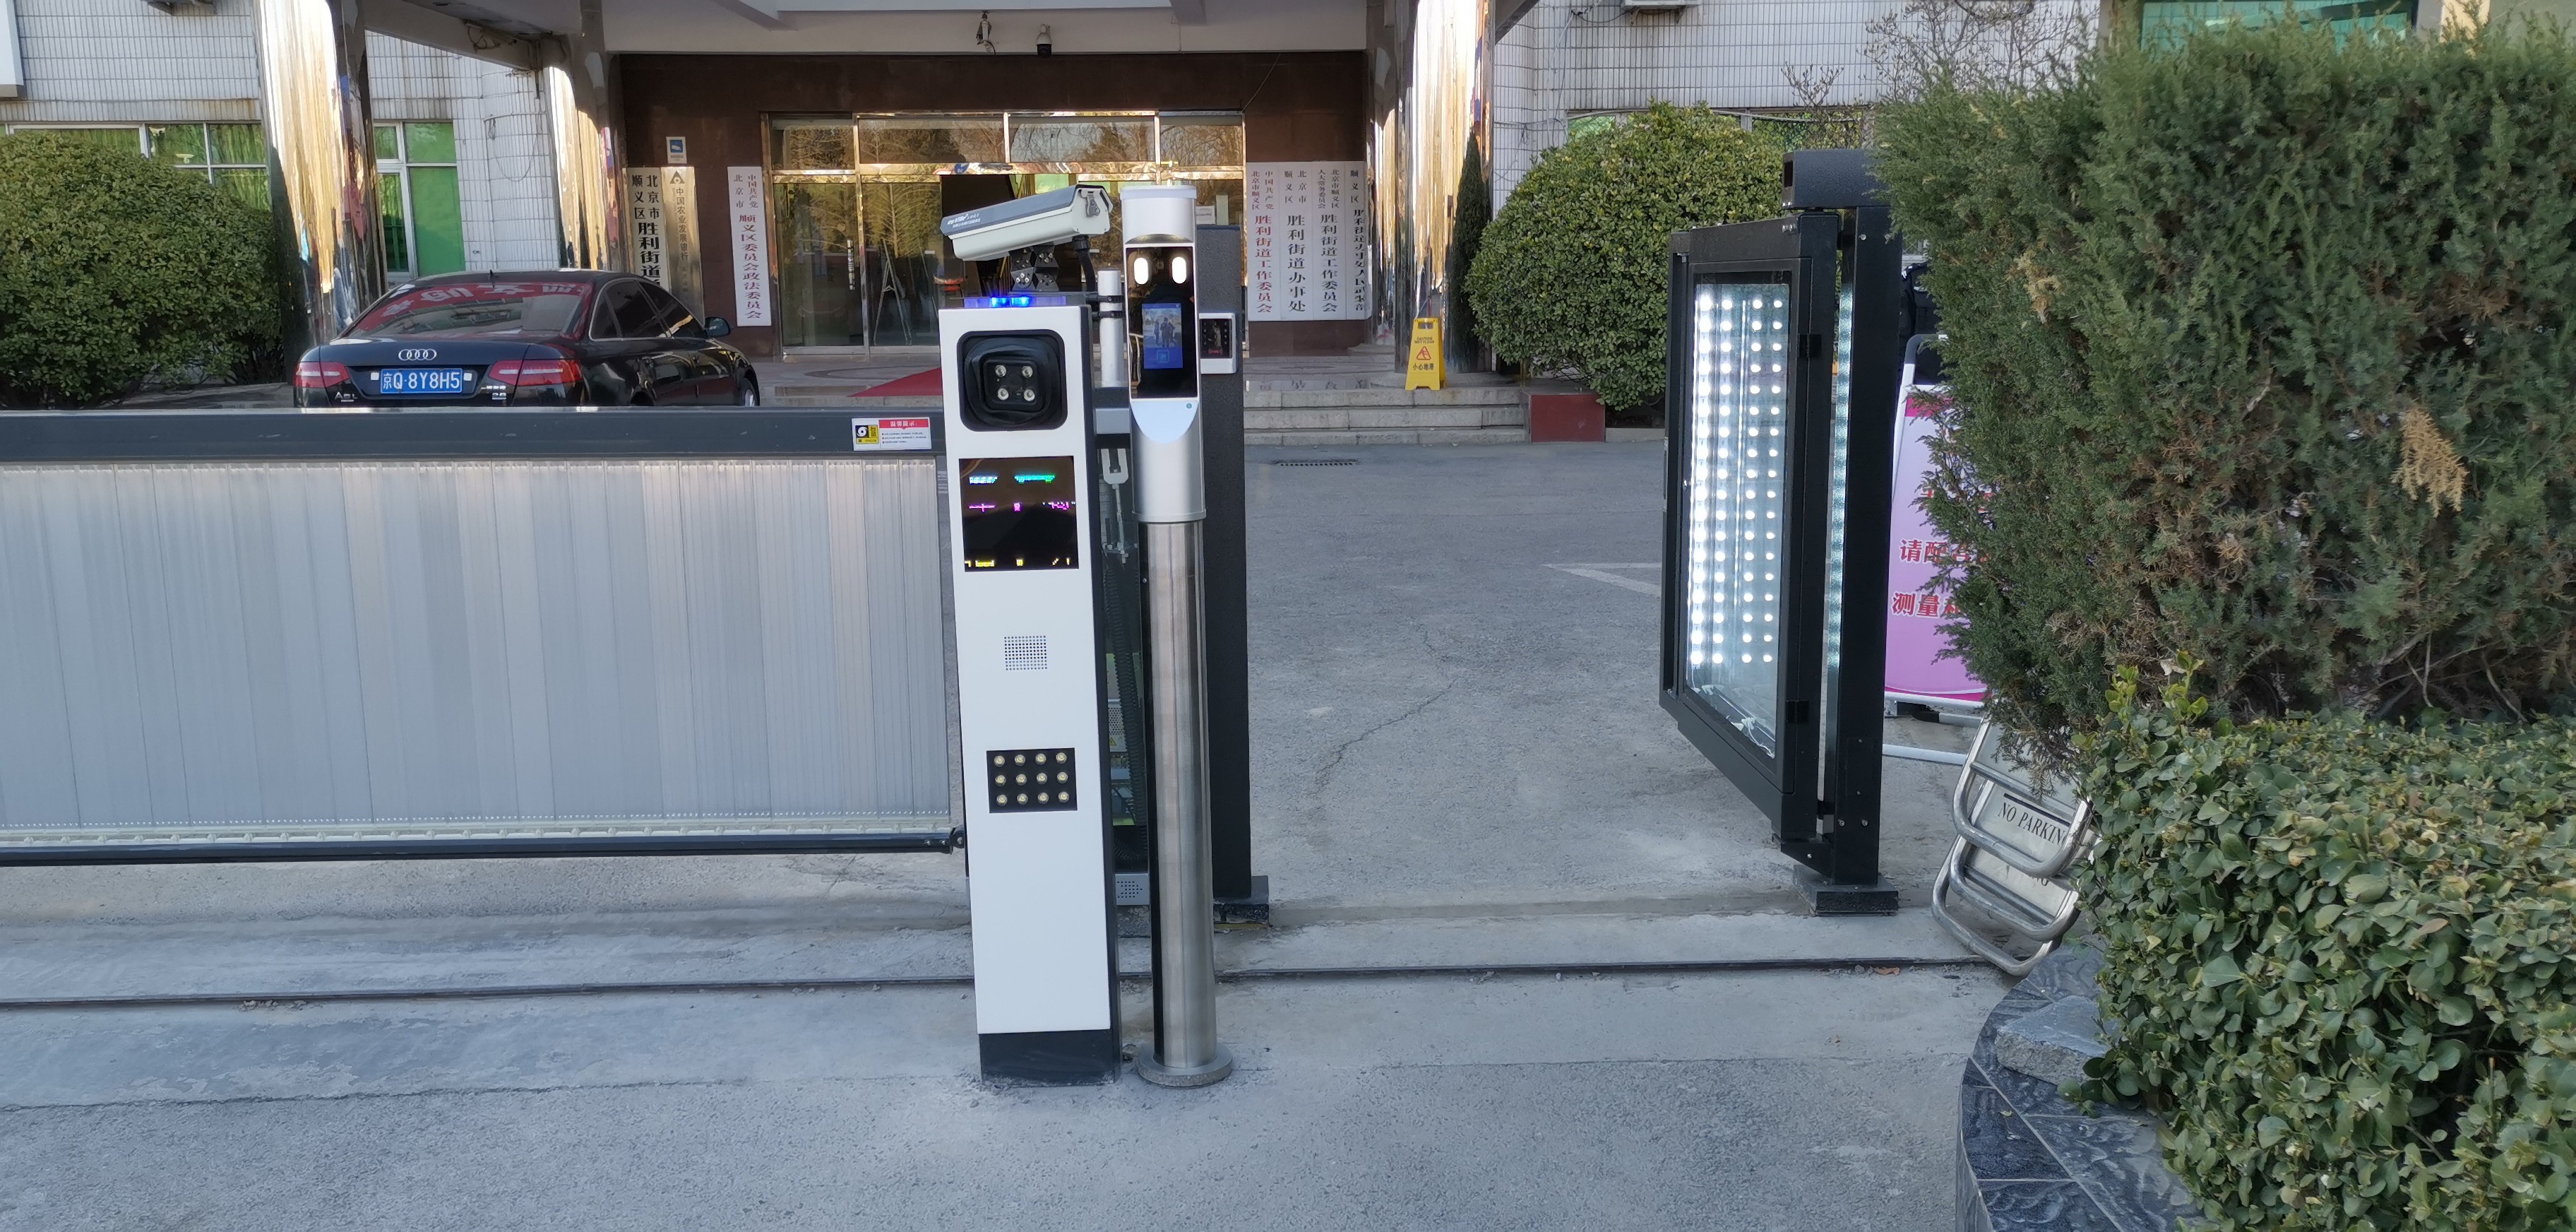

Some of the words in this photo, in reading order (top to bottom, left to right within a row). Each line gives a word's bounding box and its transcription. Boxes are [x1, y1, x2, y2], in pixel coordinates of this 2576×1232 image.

[632, 174, 646, 220] 顺义区
[647, 174, 660, 220] 北京市
[734, 174, 744, 209] 北京市
[747, 174, 758, 208] 中国共产党
[1251, 171, 1260, 210] 北京市顺义区
[1265, 170, 1274, 210] 中国共产党
[1284, 170, 1294, 203] 顺义区
[1298, 170, 1307, 203] 北京市
[1330, 169, 1340, 209] 北京市顺义区
[1350, 170, 1359, 203] 顺义区
[676, 187, 689, 261] 中国农业发展银行
[638, 222, 662, 285] 胜利街道
[739, 214, 763, 319] 顺义区委员会政法委员会
[1254, 215, 1273, 313] 胜利街道工作委员会
[1287, 215, 1306, 312] 胜利街道办事处
[1320, 214, 1338, 312] 胜利街道工作委员会
[1413, 362, 1434, 371] 小心地滑
[1997, 802, 2017, 822] NO
